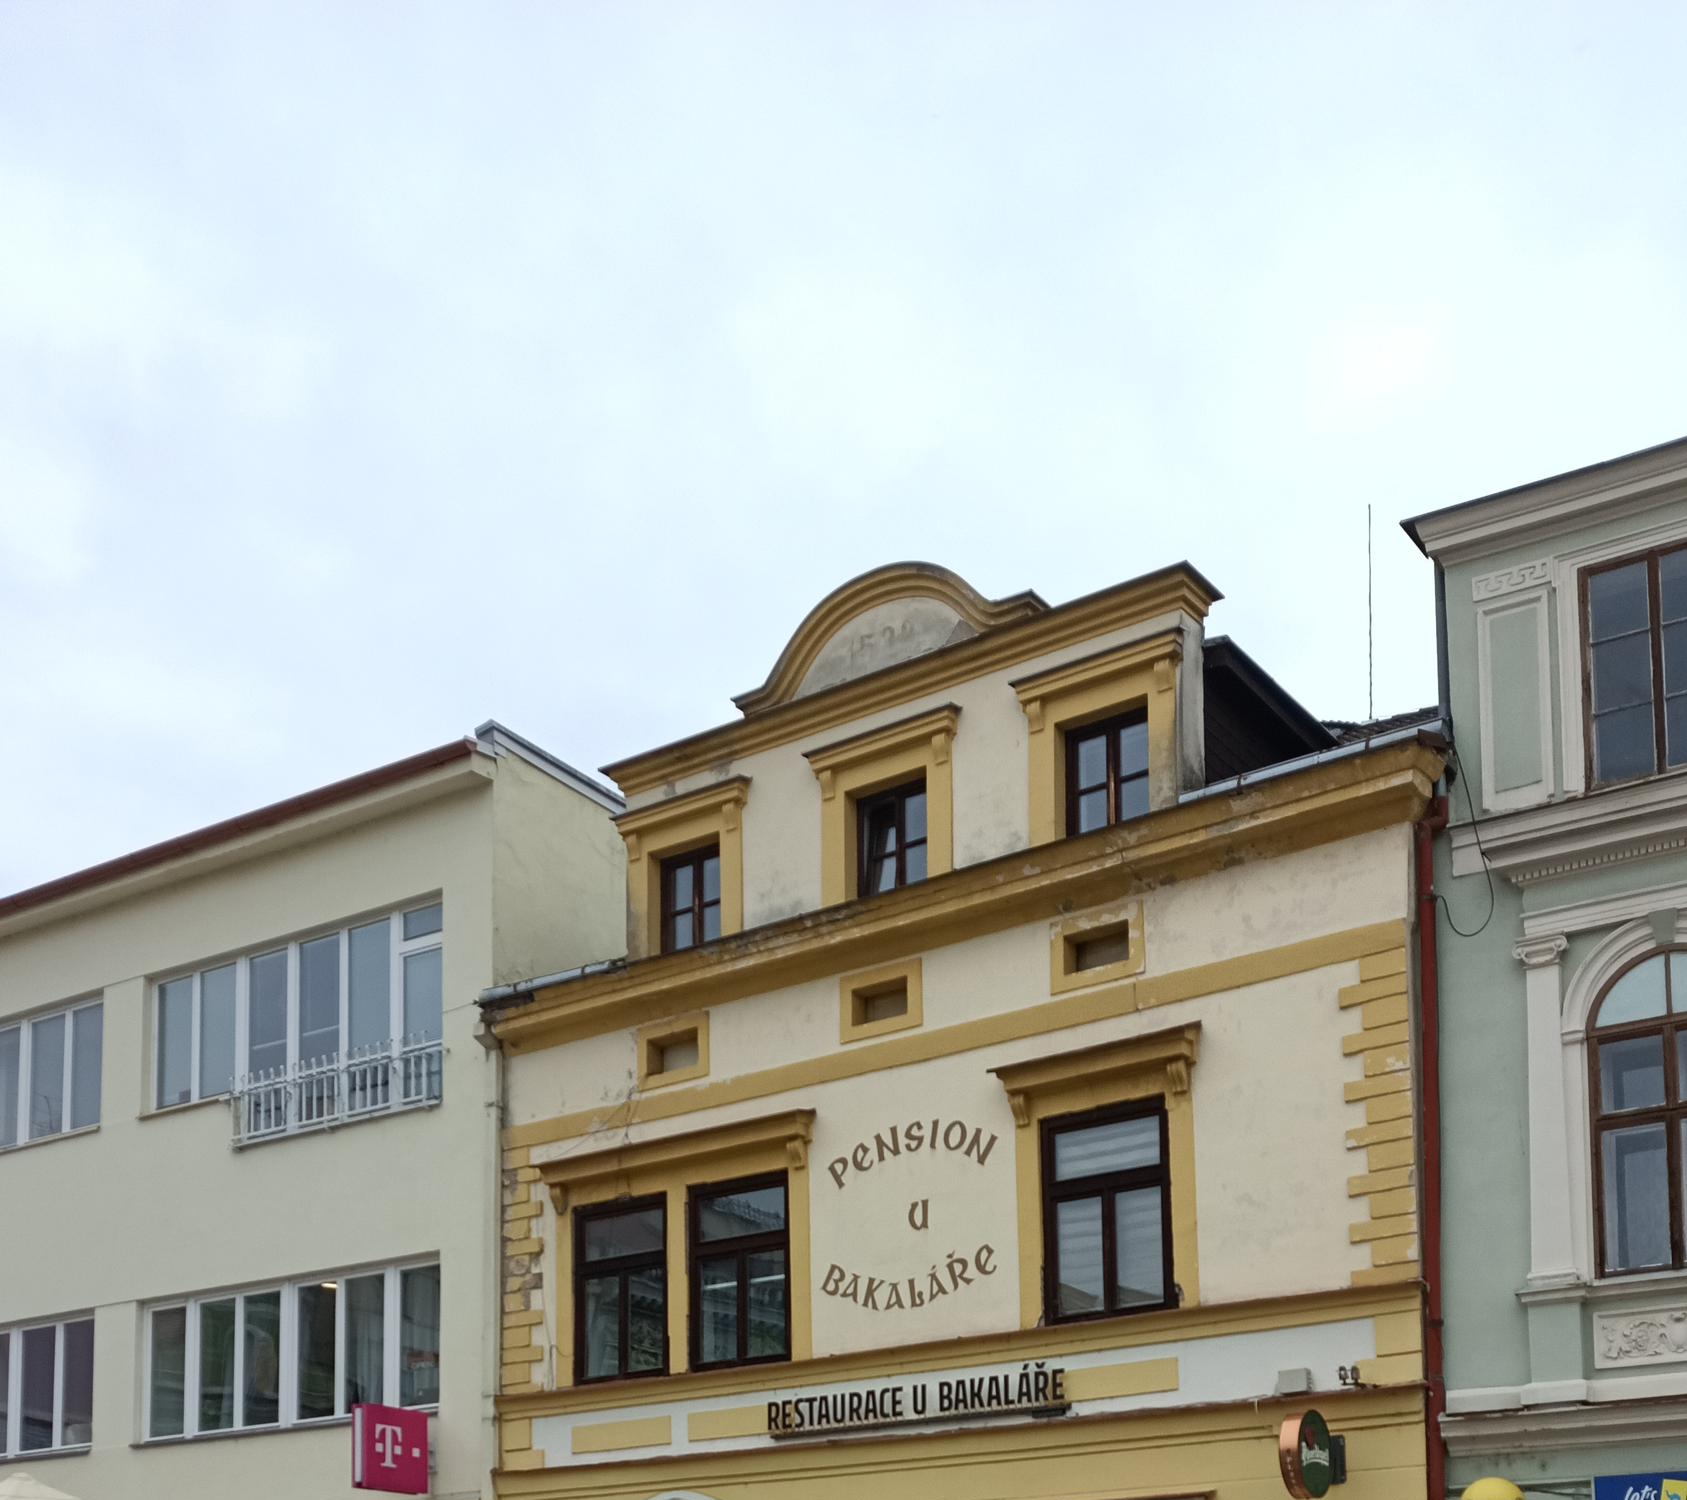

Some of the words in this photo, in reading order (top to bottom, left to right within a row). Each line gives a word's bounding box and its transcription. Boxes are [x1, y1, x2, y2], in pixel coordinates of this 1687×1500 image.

[827, 1118, 999, 1190] PENSION
[907, 1198, 930, 1231] U
[820, 1243, 998, 1312] BAKALÁŘE
[767, 1386, 904, 1431] RESTAURACE
[912, 1383, 927, 1415] U
[938, 1362, 1066, 1413] BAKALÁŘE
